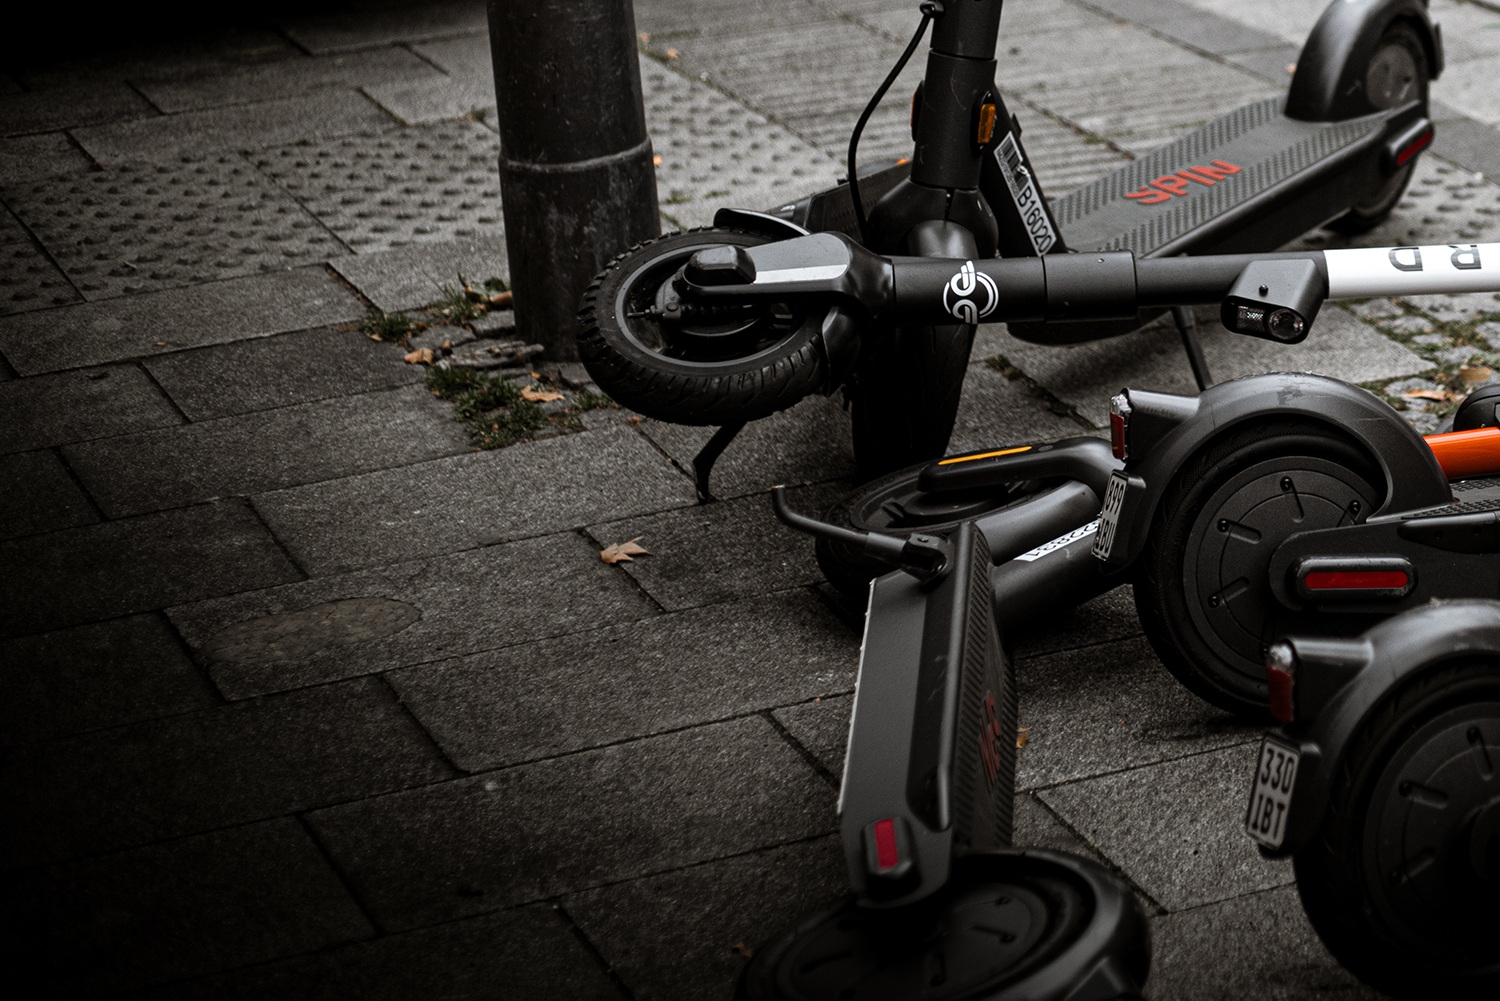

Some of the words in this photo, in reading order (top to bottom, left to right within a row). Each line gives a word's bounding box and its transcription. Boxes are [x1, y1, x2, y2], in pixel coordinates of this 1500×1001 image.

[1124, 159, 1244, 205] SPIN
[1017, 185, 1052, 254] B16020
[1261, 747, 1295, 794] 330
